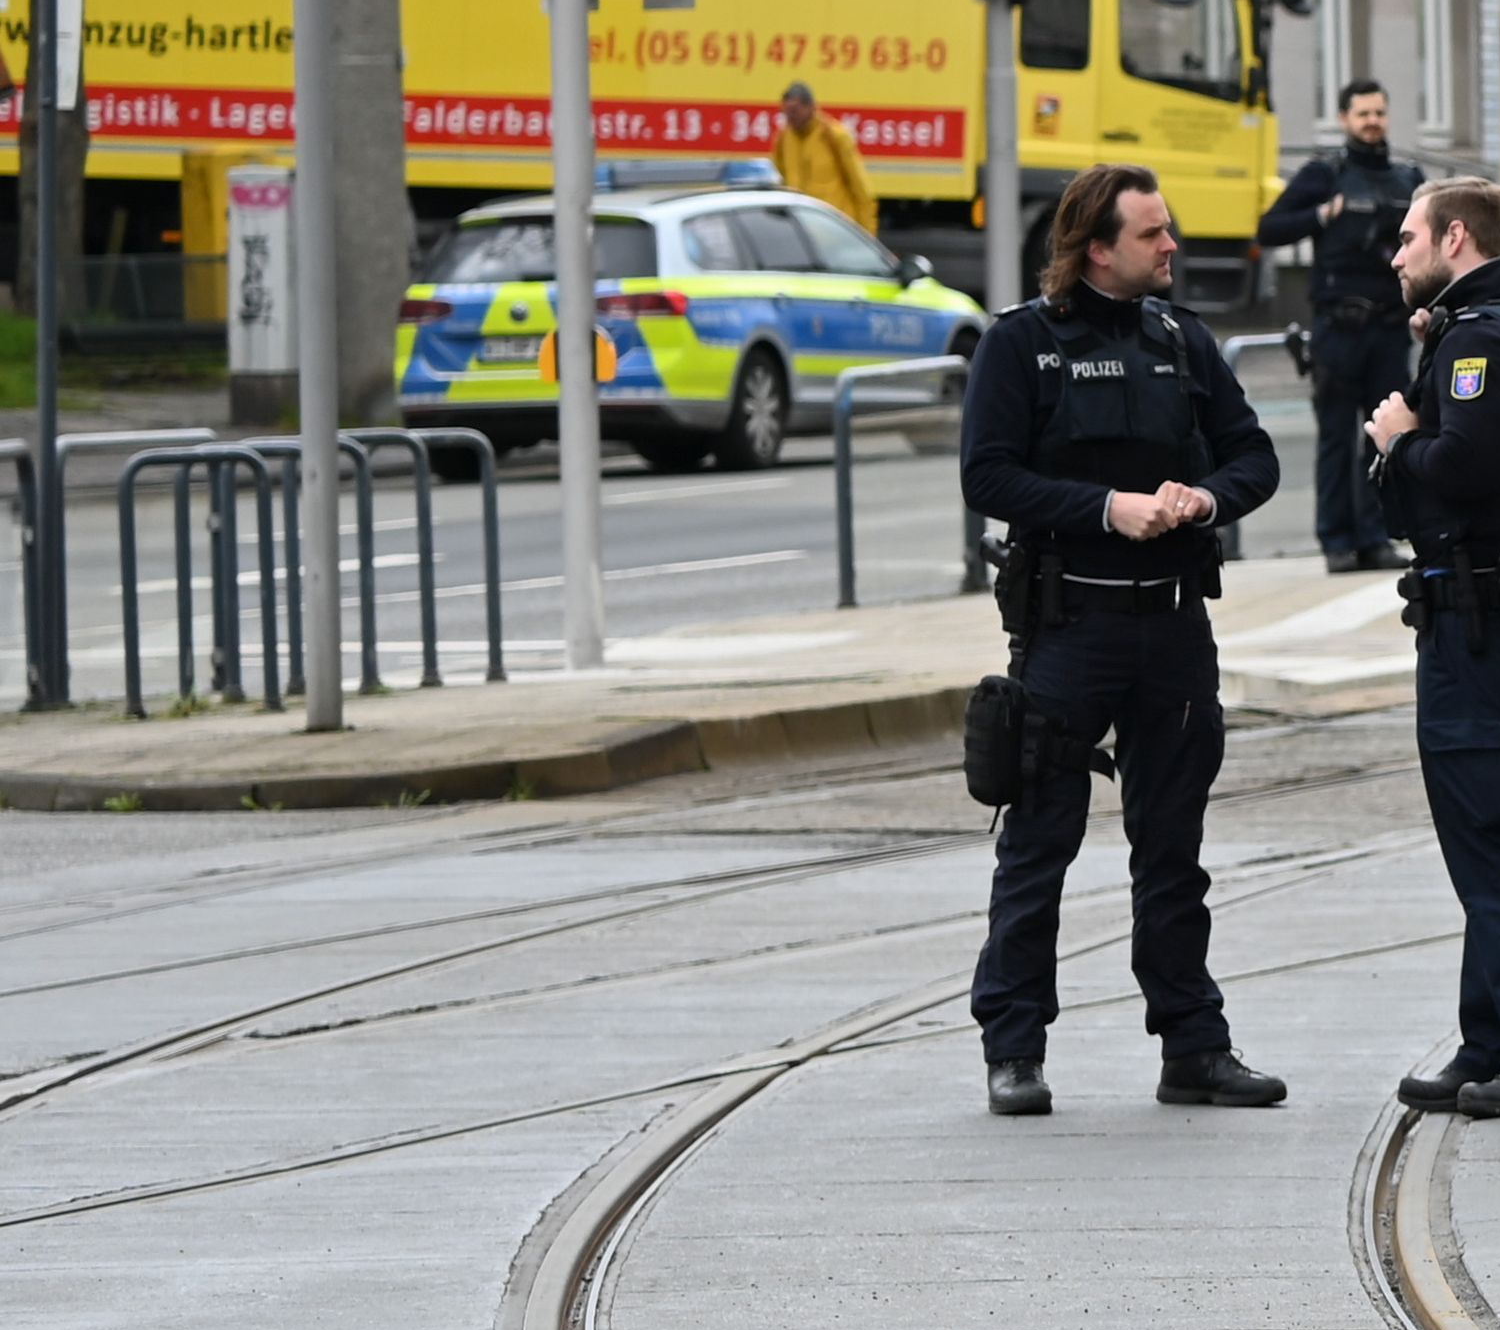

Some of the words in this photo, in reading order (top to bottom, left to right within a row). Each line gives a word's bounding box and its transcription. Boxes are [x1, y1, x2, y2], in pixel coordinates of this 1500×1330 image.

[634, 29, 690, 71] (05
[701, 30, 757, 71] 61)
[766, 33, 808, 64] 47
[818, 36, 860, 67] 59
[869, 38, 948, 71] 63-0
[663, 109, 702, 141] 13
[1071, 360, 1125, 380] POLIZEI
